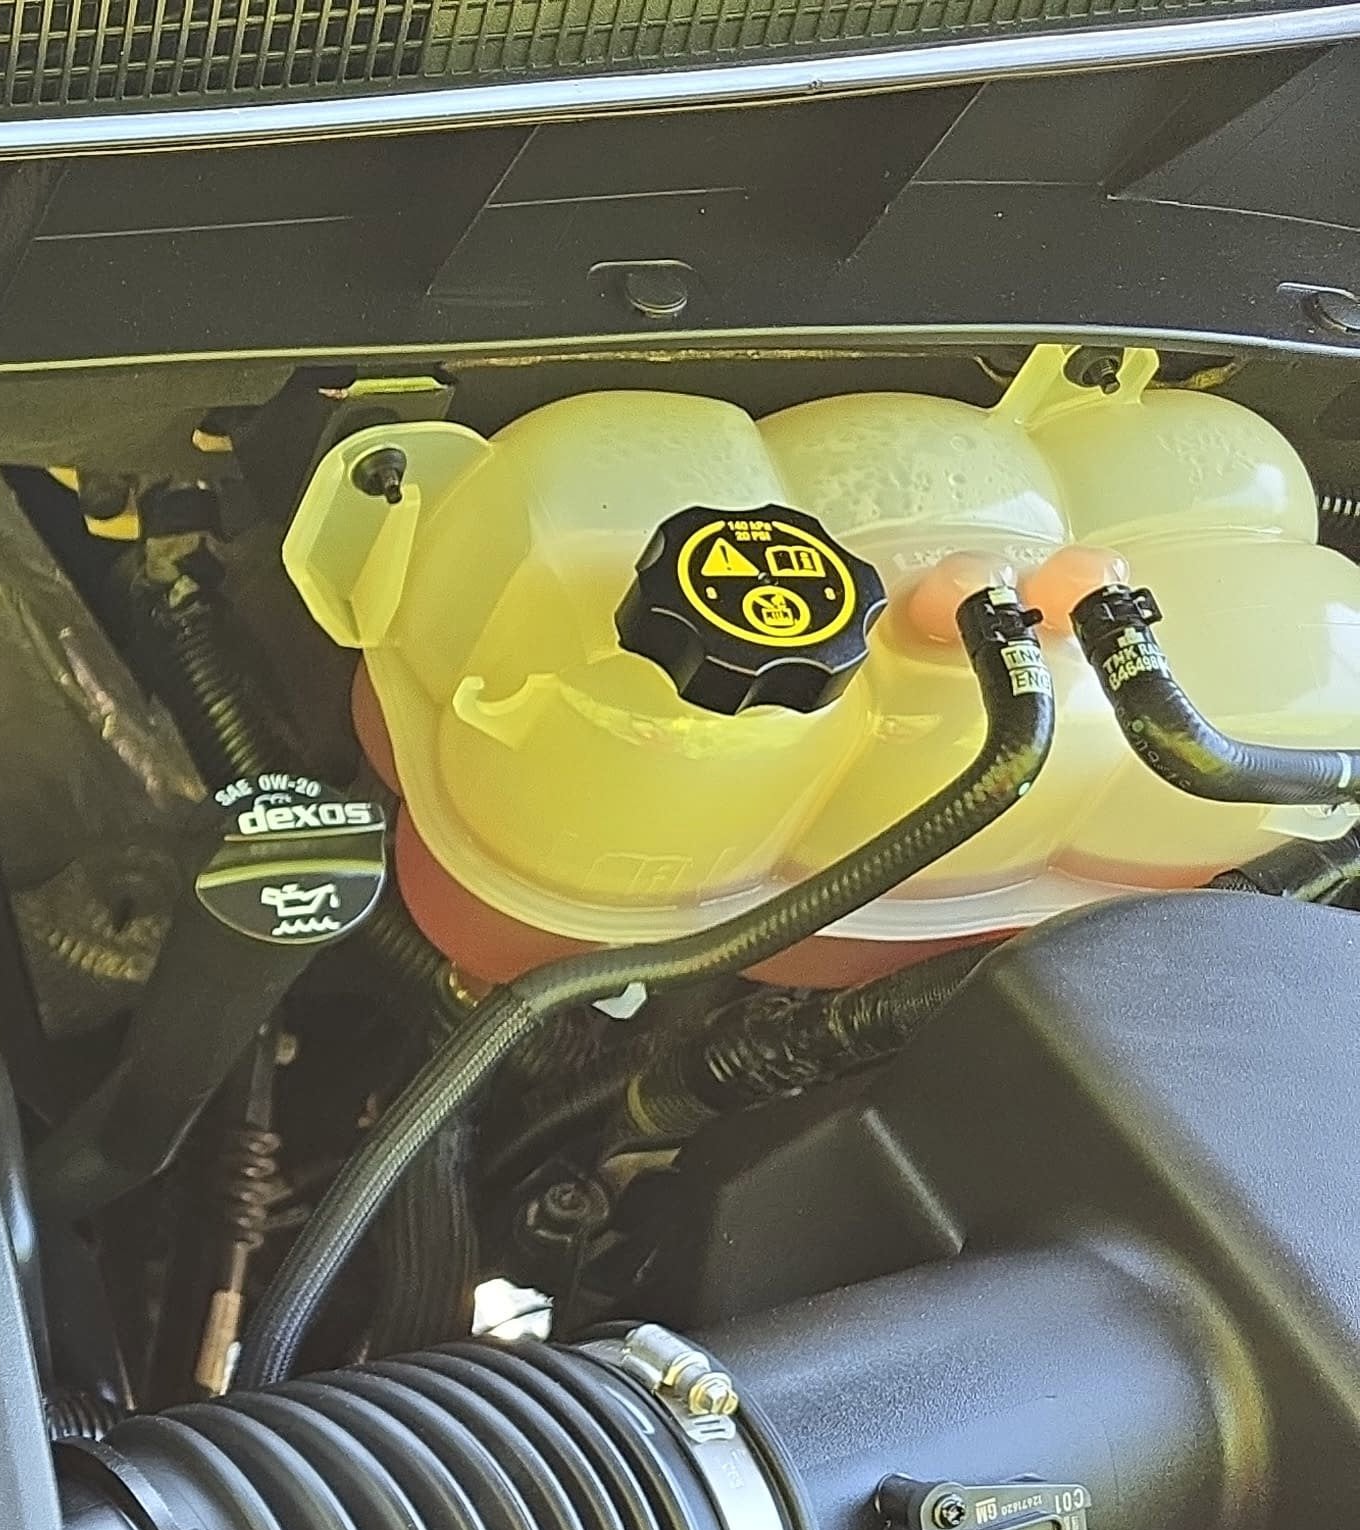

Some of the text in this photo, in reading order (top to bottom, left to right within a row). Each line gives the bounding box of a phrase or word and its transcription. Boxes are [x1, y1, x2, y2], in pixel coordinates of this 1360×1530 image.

[1102, 645, 1138, 674] TNK
[1014, 670, 1050, 690] ENG
[214, 773, 322, 807] SAE 0W-20
[237, 801, 372, 836] dexos
[975, 1501, 998, 1525] GM
[1054, 1487, 1085, 1515] C01
